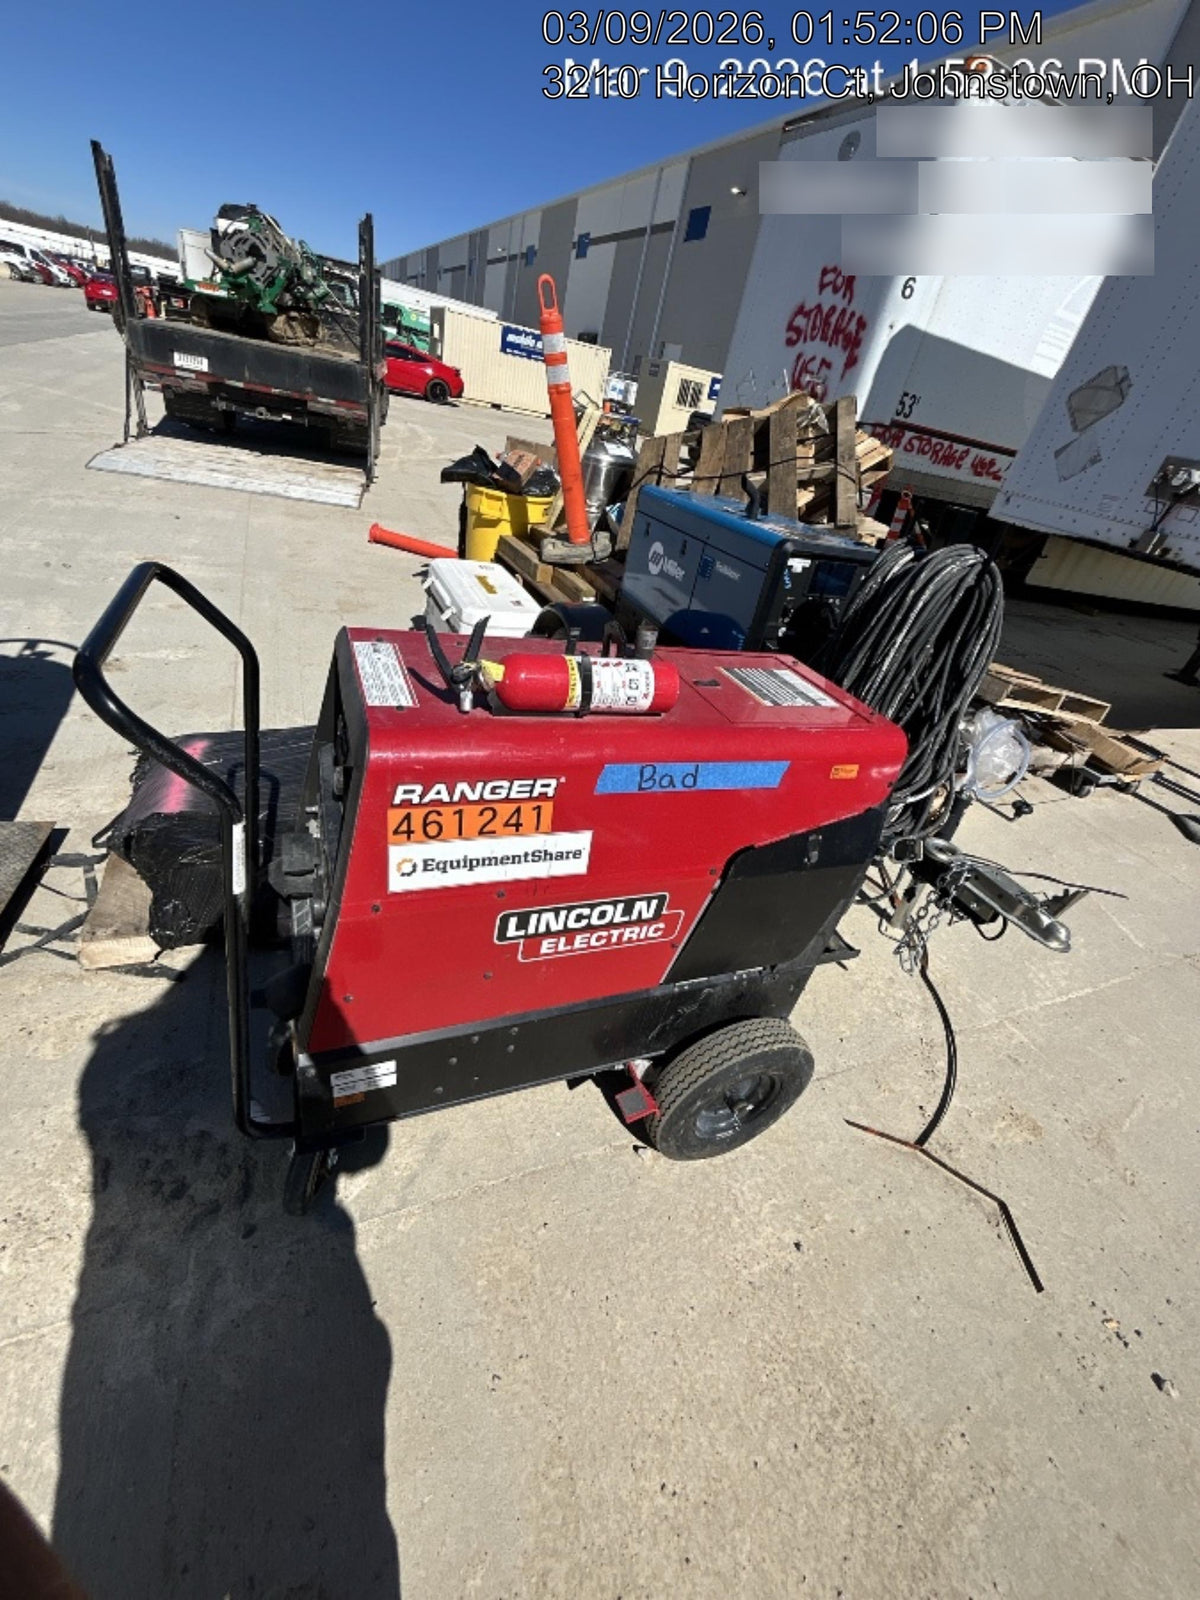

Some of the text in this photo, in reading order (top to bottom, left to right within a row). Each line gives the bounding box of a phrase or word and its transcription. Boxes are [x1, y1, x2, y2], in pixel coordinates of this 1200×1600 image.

[818, 265, 857, 306] FOR
[900, 276, 917, 300] 6
[391, 777, 559, 807] RANGER
[638, 763, 700, 792] Bad
[391, 804, 544, 842] 461241
[421, 846, 583, 875] EquipmentShare
[505, 898, 659, 939] LINCOLN
[539, 922, 666, 955] ELECTRIC
